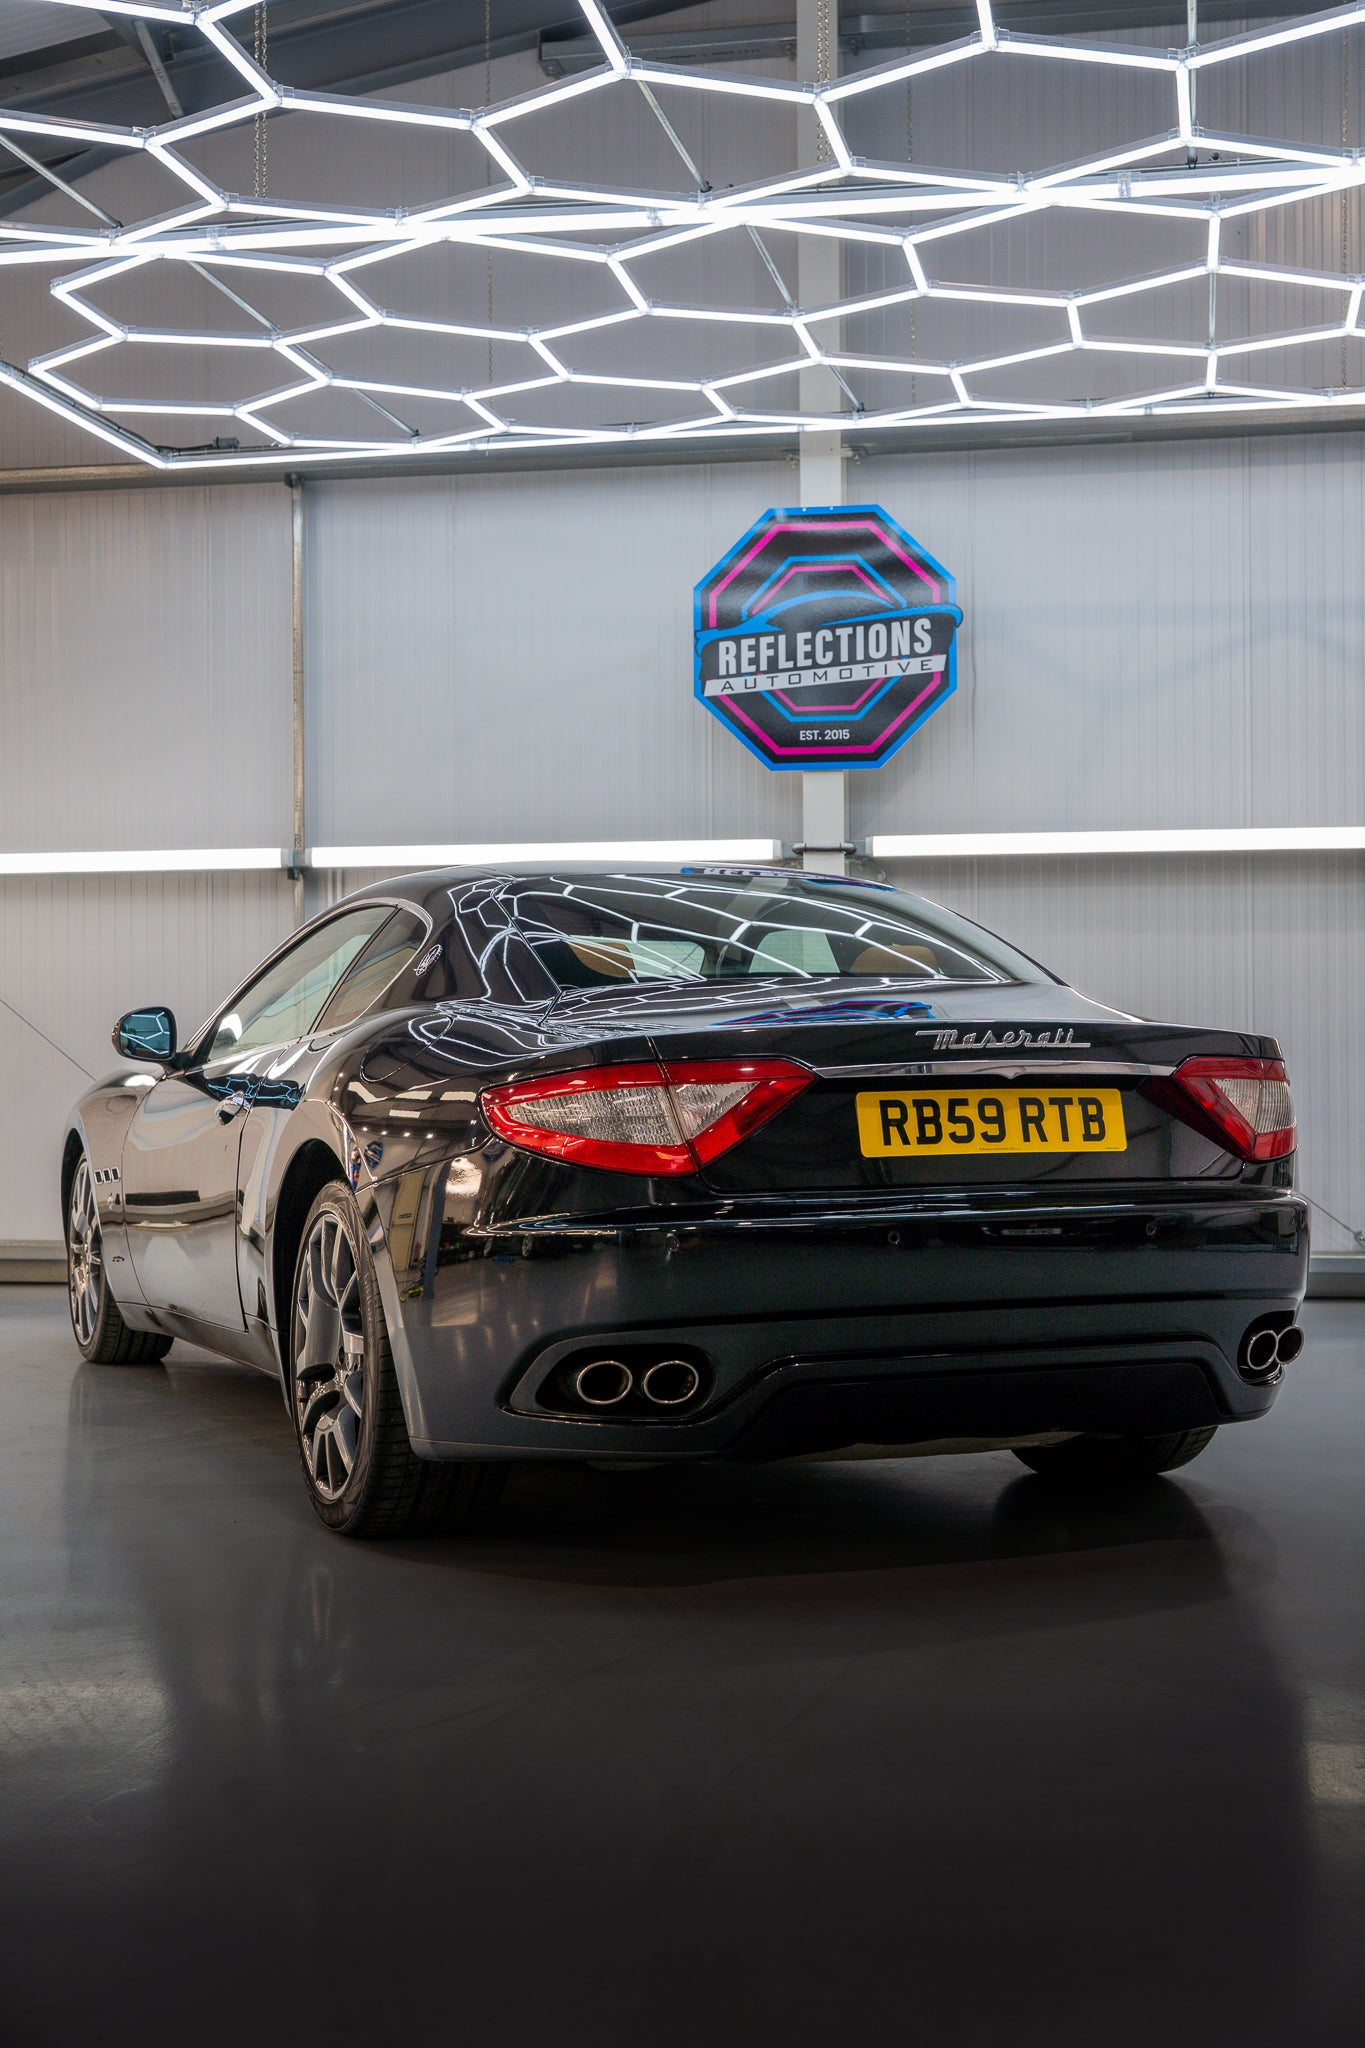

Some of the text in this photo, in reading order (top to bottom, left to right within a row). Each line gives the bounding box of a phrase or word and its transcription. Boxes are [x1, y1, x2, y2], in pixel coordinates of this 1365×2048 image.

[718, 618, 932, 676] REFLECTIONS
[720, 659, 933, 692] AUTOMOTIVE
[800, 729, 850, 741] EST. 2015
[915, 1028, 1091, 1050] Maserati
[879, 1096, 1106, 1147] RB59 RTB
